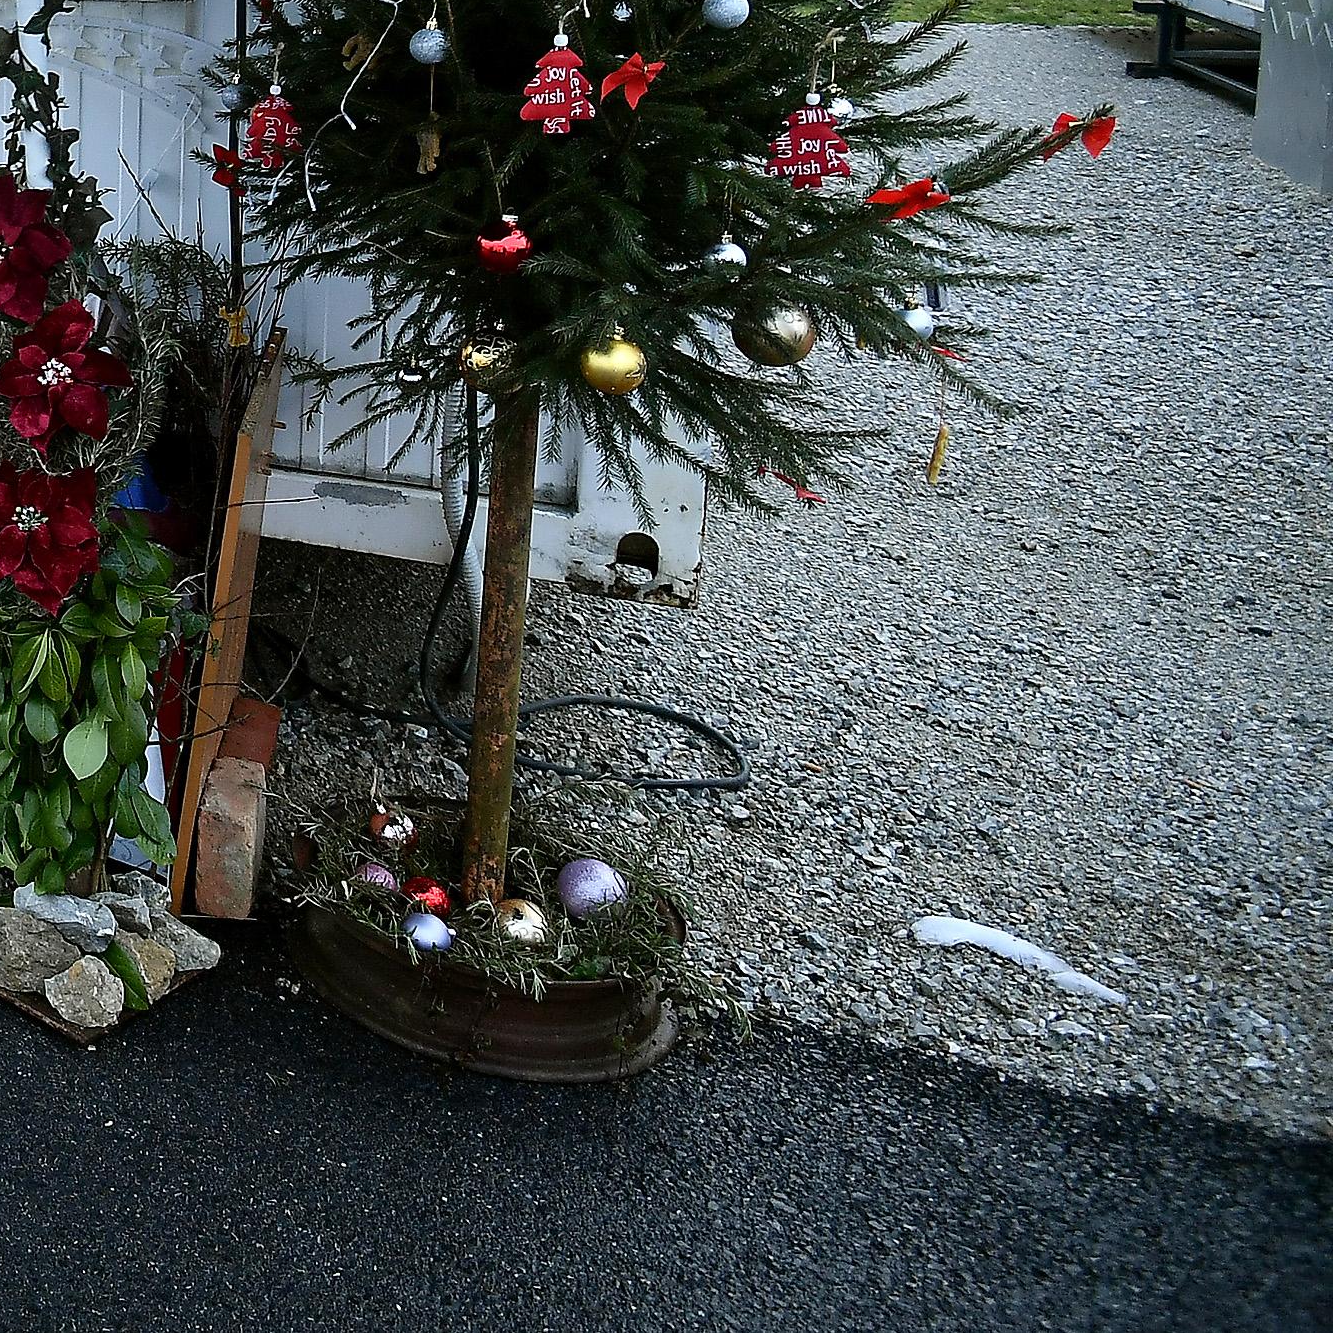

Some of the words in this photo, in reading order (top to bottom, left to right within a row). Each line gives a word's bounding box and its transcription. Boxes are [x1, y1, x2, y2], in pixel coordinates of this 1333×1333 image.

[545, 66, 566, 82] joy
[531, 88, 566, 105] wish
[795, 108, 831, 125] TIME
[797, 138, 821, 154] joy
[782, 160, 821, 176] wish
